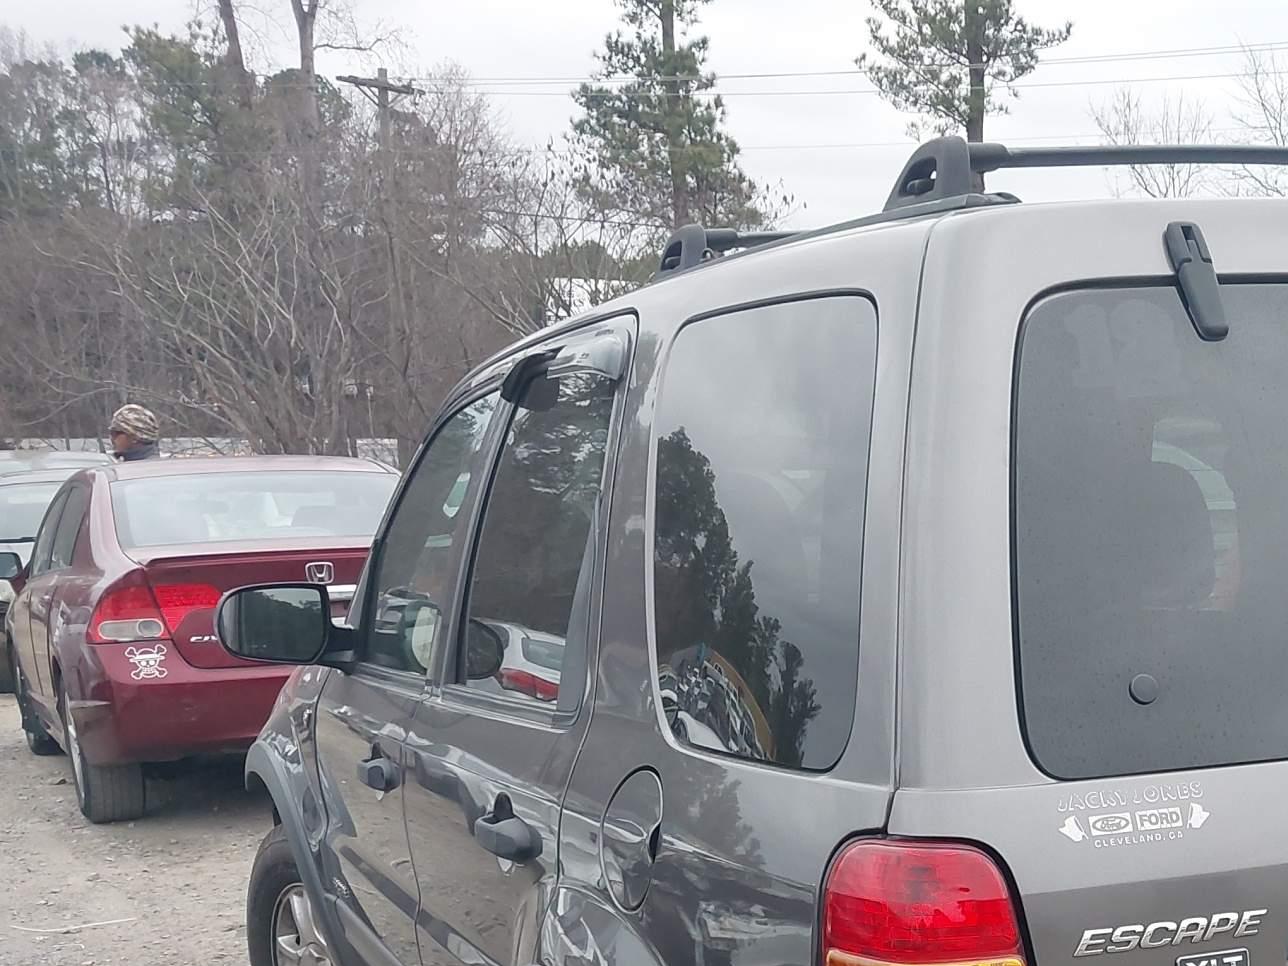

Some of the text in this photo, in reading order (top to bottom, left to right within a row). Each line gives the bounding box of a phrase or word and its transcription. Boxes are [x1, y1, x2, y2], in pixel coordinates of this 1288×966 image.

[1057, 781, 1204, 813] JACKY JONES
[1138, 810, 1181, 829] FORD
[1168, 830, 1184, 840] GA
[1072, 908, 1268, 958] ESCAPE
